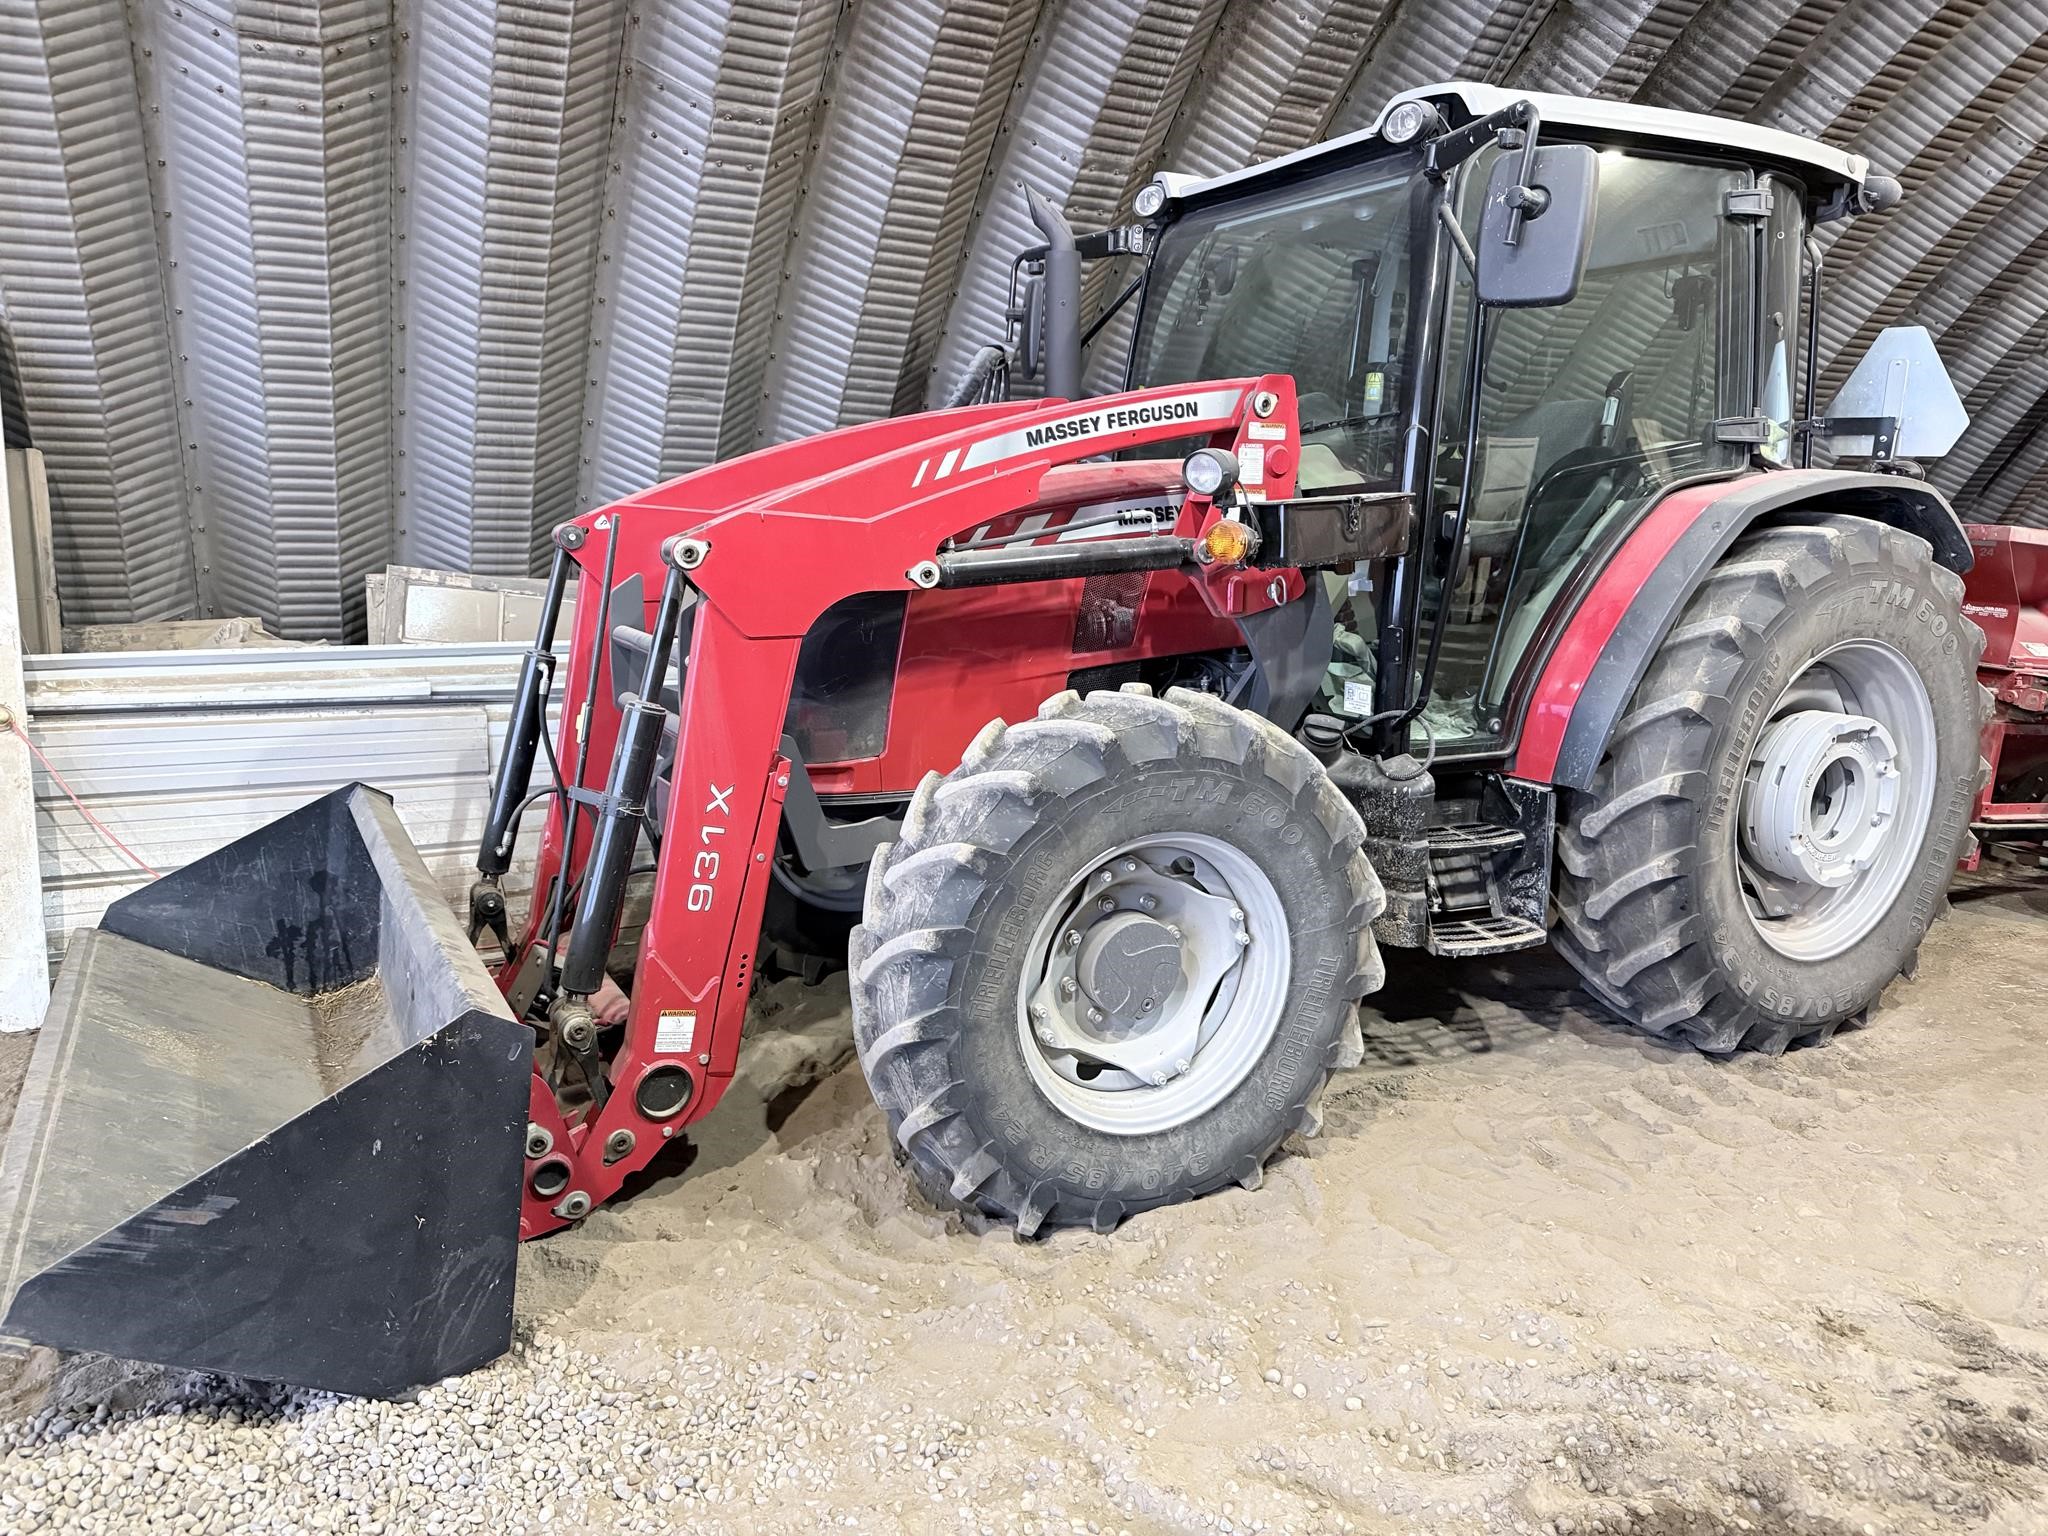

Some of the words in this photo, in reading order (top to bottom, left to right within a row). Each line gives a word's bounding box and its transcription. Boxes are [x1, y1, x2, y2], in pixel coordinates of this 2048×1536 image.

[1026, 417, 1101, 448] MASSEY
[1107, 401, 1198, 429] FERGUSON
[1980, 547, 1994, 557] 24
[1868, 578, 1917, 610] TM
[1915, 598, 1959, 656] 600
[1703, 651, 1780, 836] TRELLEBORG
[704, 781, 736, 817] X
[1170, 777, 1234, 804] TM
[1239, 792, 1304, 845] 600
[687, 824, 727, 913] 931
[968, 850, 1054, 1020] TRELLEBORG
[1264, 955, 1343, 1112] TRELLEBORG
[990, 1102, 1029, 1146] 24
[1027, 1143, 1058, 1170] R
[1060, 1151, 1210, 1192] 340/85
